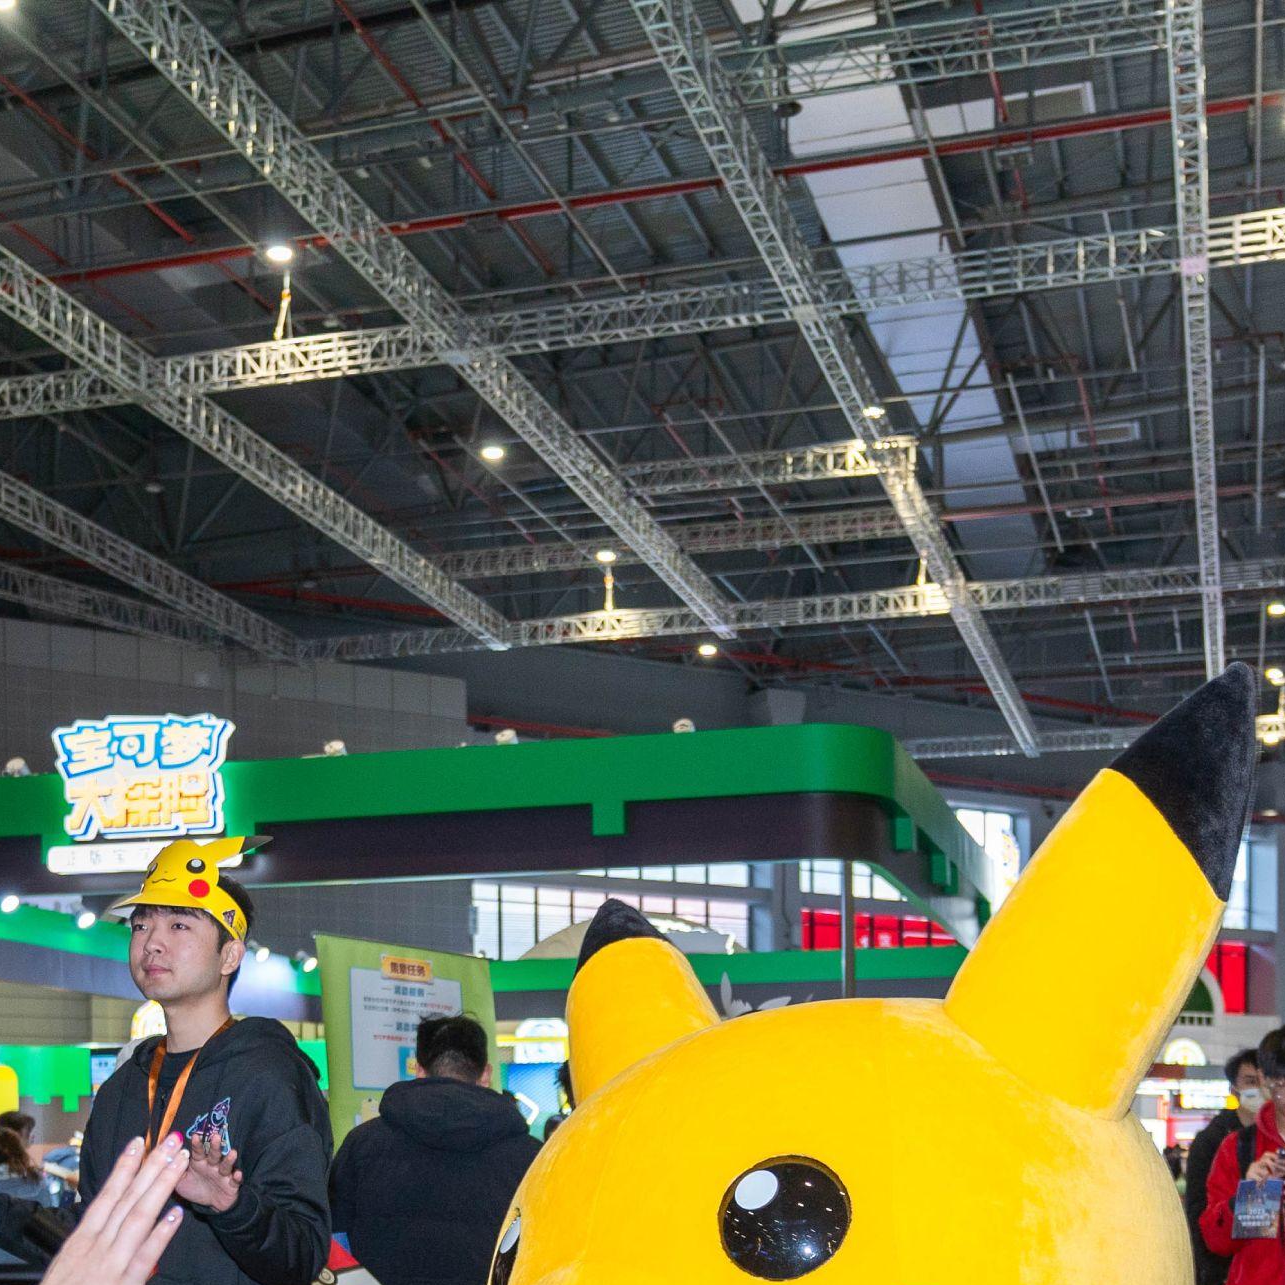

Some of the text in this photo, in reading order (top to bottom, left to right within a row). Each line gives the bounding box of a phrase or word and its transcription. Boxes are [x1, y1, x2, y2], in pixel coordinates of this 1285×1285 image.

[60, 720, 215, 777] 宝可梦
[68, 771, 211, 830] 大探险
